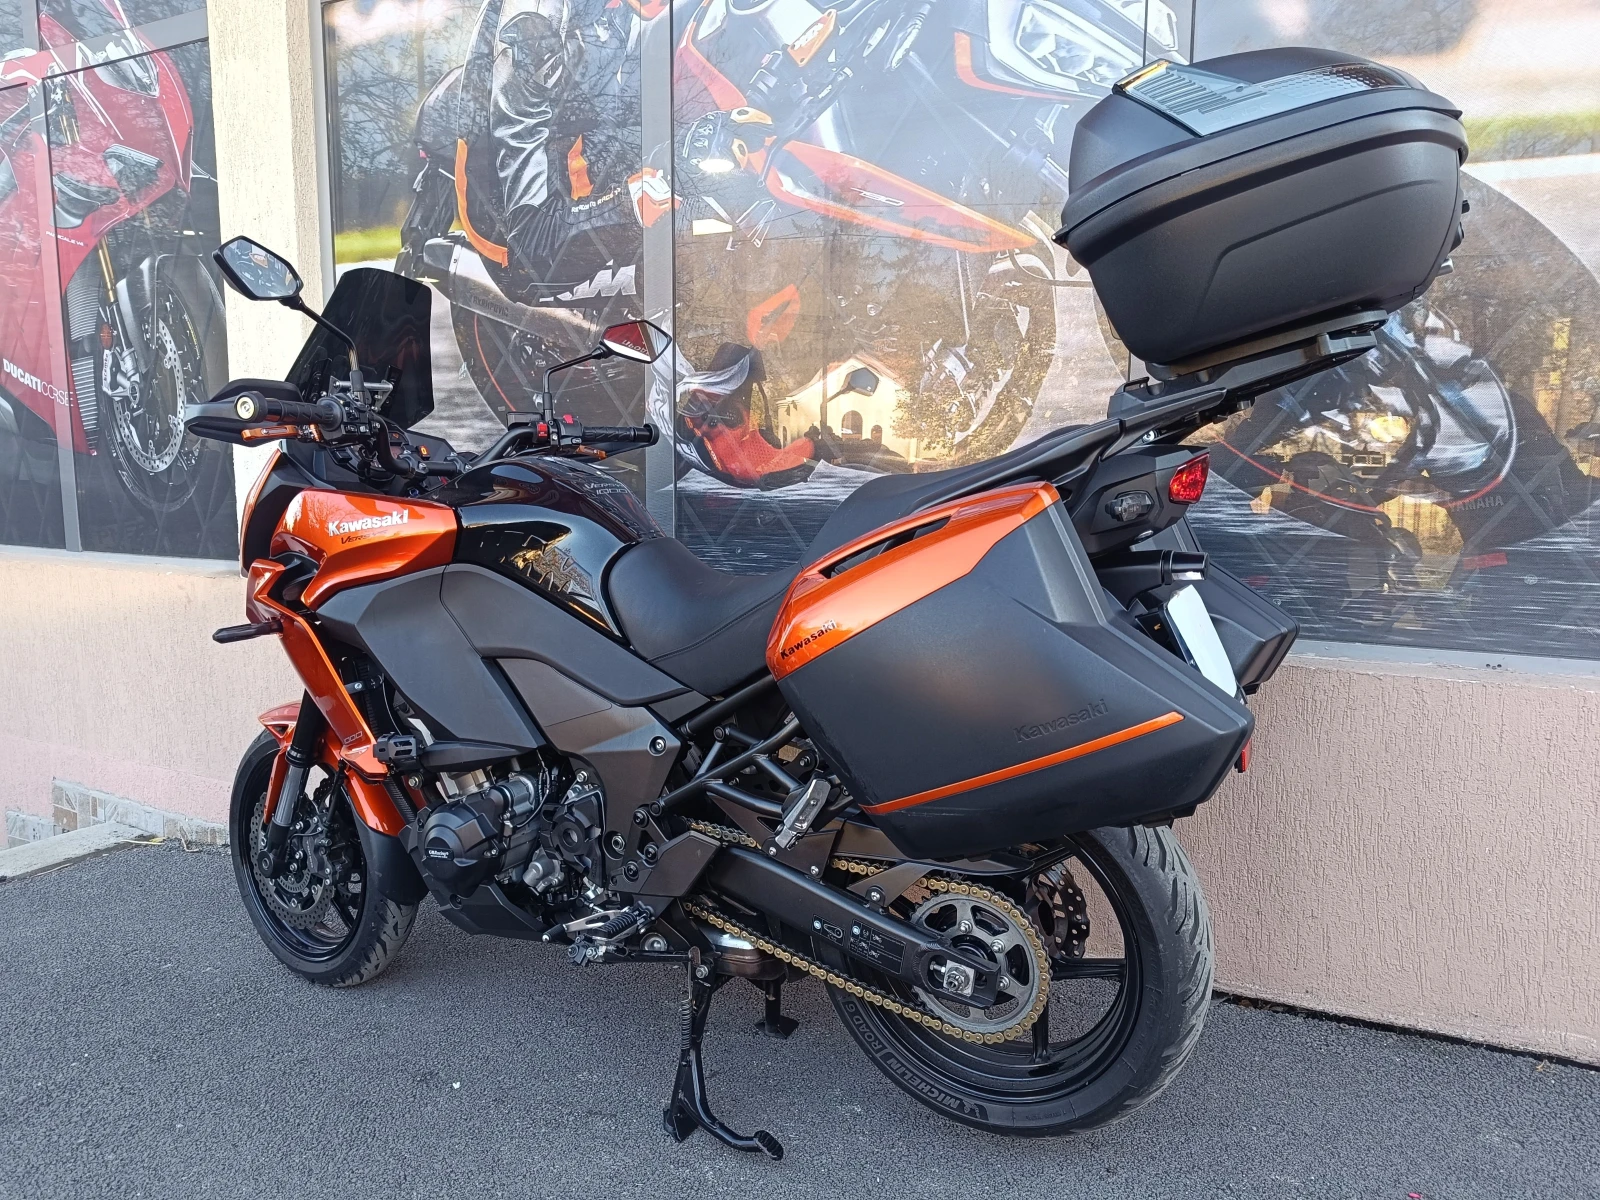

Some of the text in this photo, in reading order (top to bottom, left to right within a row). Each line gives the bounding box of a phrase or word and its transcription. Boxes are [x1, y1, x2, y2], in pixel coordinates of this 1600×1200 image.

[2, 358, 42, 393] DUCATI
[328, 508, 409, 537] Kawasaki
[780, 618, 837, 661] Kawasaki
[1013, 698, 1109, 744] Kawasaki
[852, 1015, 883, 1052] ROAD
[886, 1056, 961, 1109] MICHELIN
